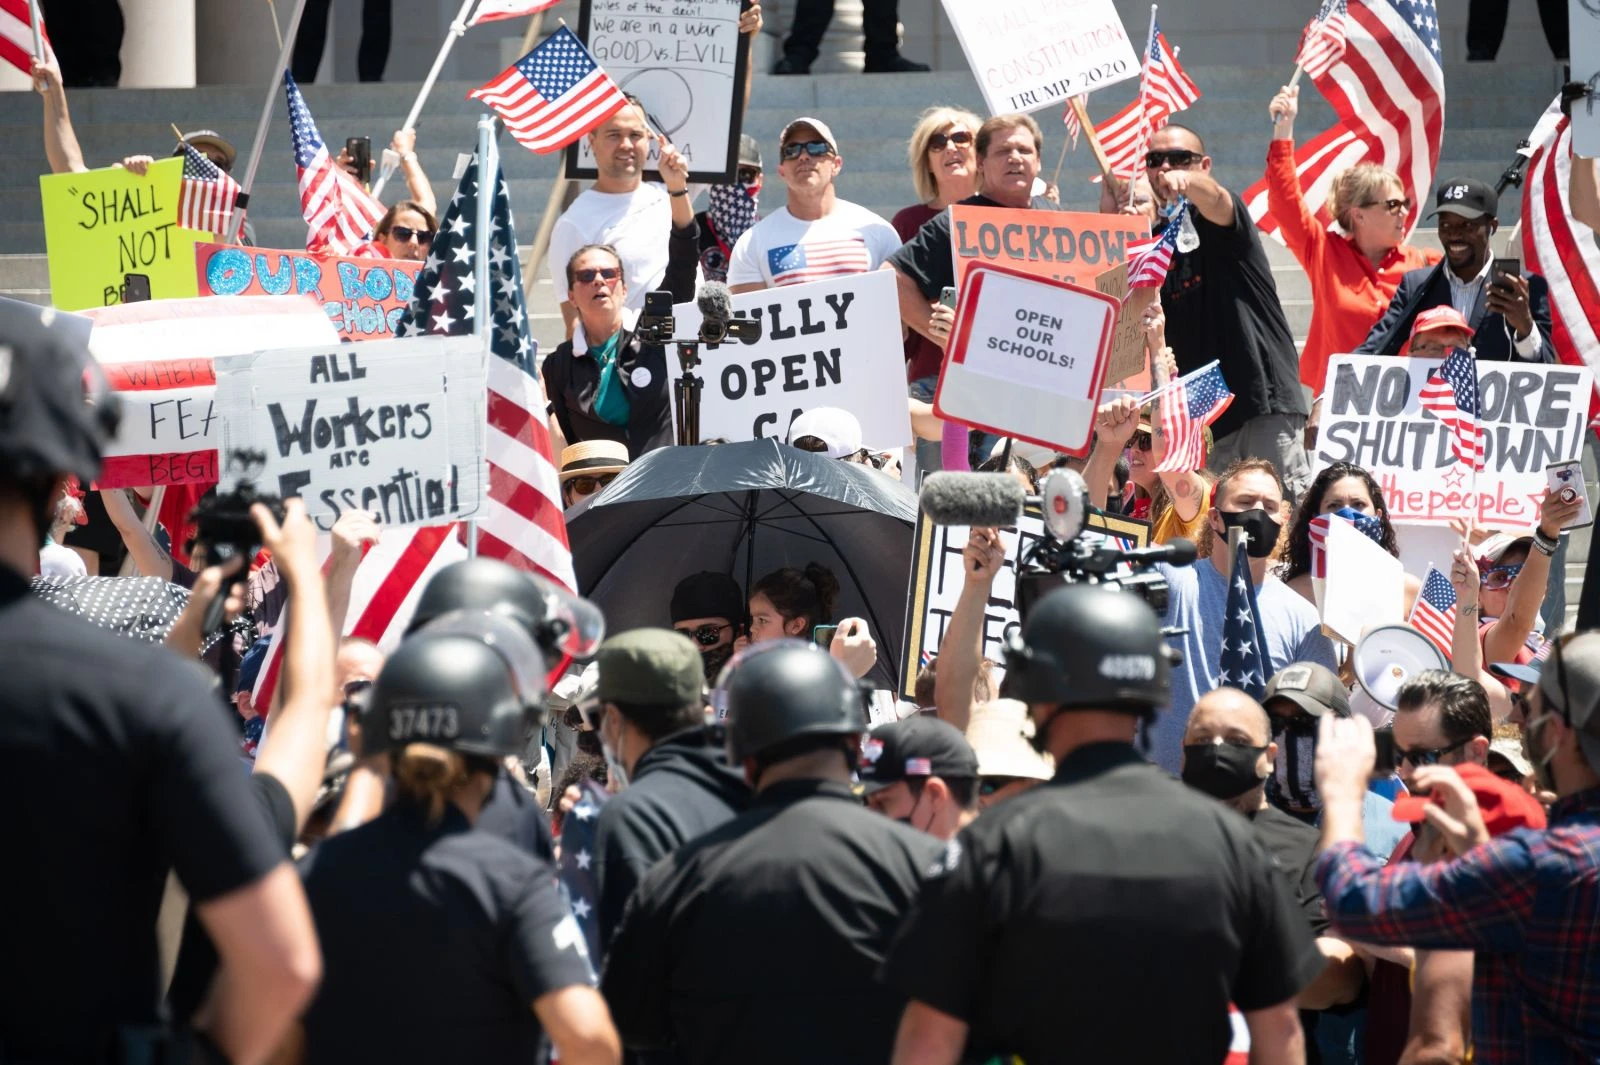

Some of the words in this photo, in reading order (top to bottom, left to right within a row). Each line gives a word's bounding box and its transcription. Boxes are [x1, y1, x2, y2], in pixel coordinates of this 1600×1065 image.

[593, 17, 615, 34] We
[619, 20, 642, 34] are
[648, 21, 662, 34] in
[668, 23, 678, 35] a
[685, 22, 721, 38] war
[627, 2, 639, 12] of
[644, 2, 663, 15] the
[592, 35, 653, 64] GOOD
[675, 39, 734, 65] EVIL
[986, 21, 1124, 90] CONSTITUTION
[1009, 77, 1072, 111] TRUMP
[1079, 58, 1127, 87] 2020
[118, 221, 177, 273] NOT
[206, 248, 325, 300] OUR
[337, 260, 420, 302] BOD
[732, 291, 855, 346] ULLY
[1015, 308, 1063, 331] OPEN
[1016, 326, 1054, 346] OUR
[310, 352, 367, 384] ALL
[720, 347, 842, 400] OPEN
[986, 336, 1075, 370] SCHOOLS!
[1331, 363, 1411, 418] NO
[1422, 366, 1581, 429] ORE
[266, 396, 432, 458] Workers
[1381, 473, 1424, 513] the
[1428, 481, 1525, 524] people
